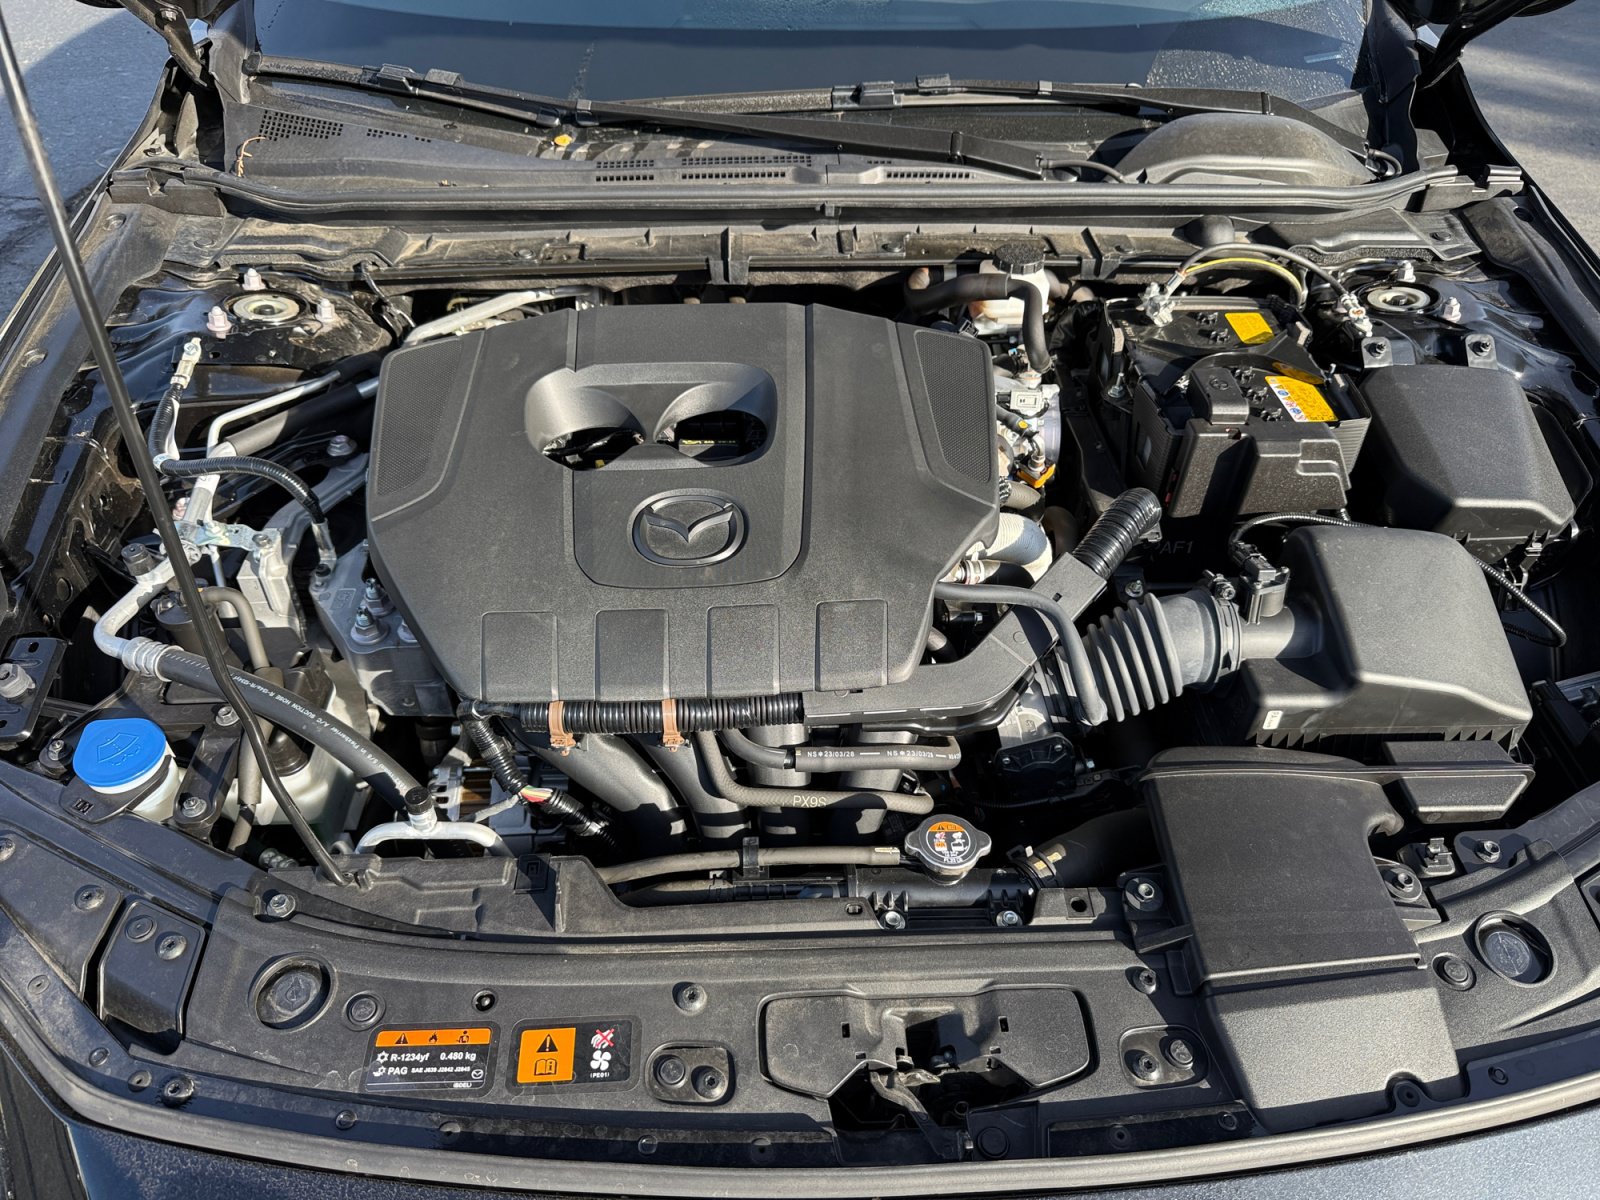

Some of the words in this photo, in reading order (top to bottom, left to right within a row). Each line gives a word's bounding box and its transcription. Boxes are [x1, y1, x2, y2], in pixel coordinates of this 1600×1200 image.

[275, 694, 291, 705] HOSE
[291, 703, 316, 719] SUCTION
[316, 717, 330, 727] A/C
[793, 794, 827, 808] PX9S
[390, 1052, 430, 1063] R-1234yf
[440, 1052, 464, 1061] 0.480
[465, 1051, 477, 1062] kg
[387, 1066, 409, 1076] PAG
